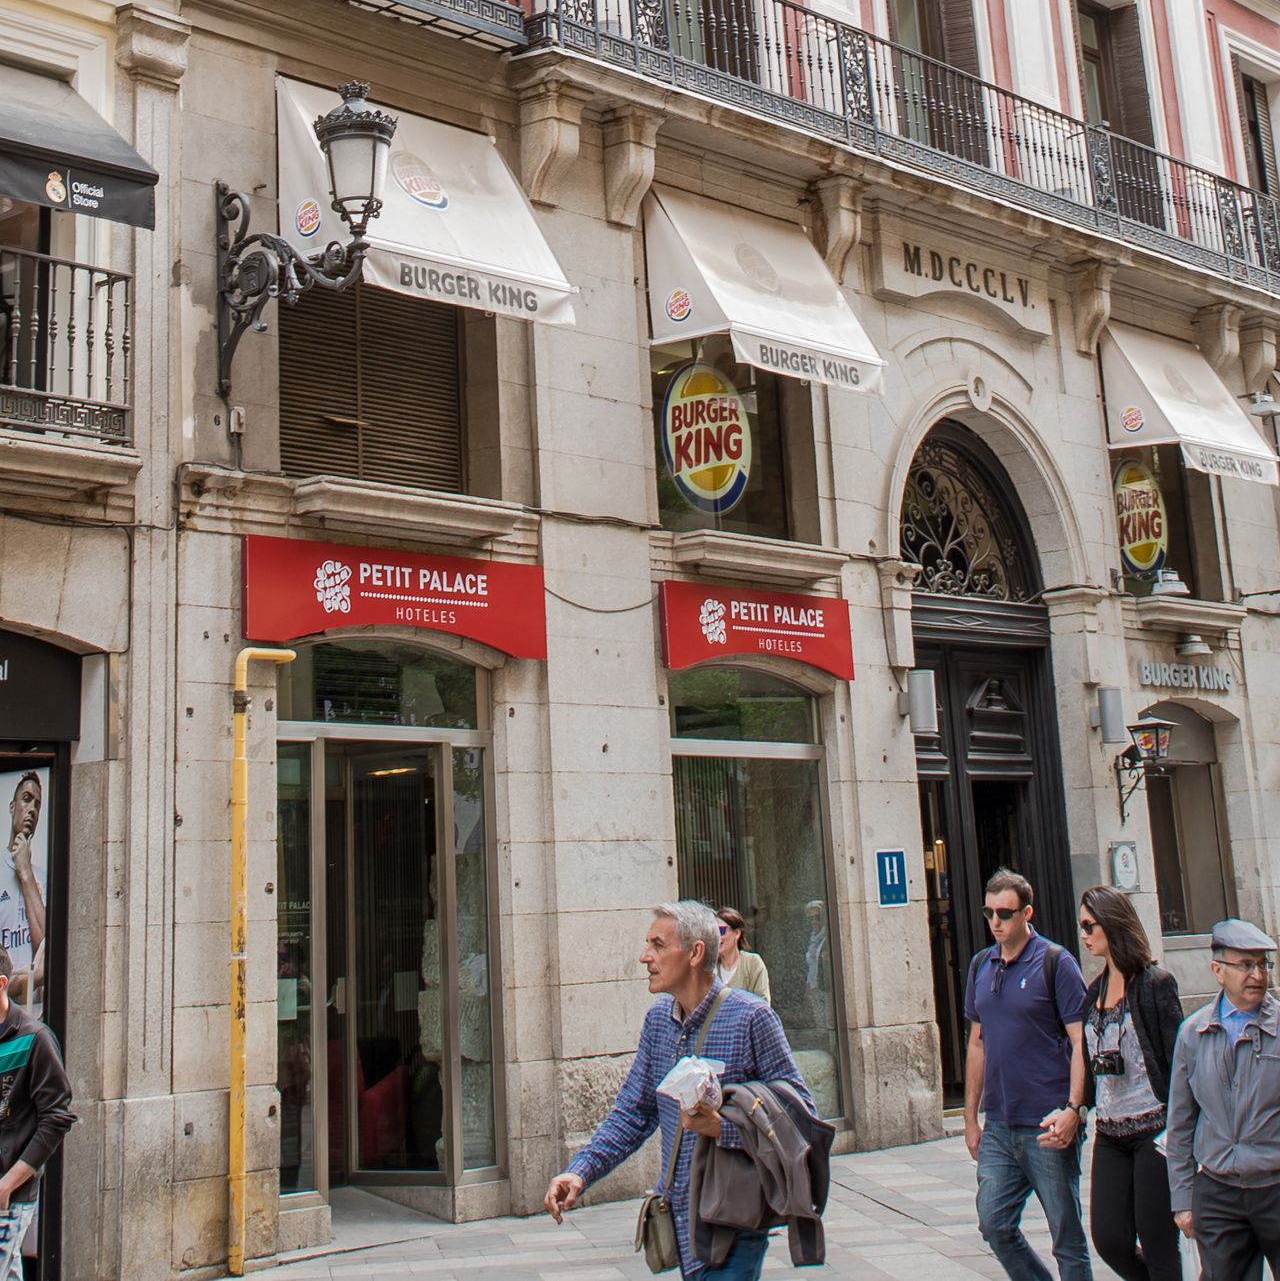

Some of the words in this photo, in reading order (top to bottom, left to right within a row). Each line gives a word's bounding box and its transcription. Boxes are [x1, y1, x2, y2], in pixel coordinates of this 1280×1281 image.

[71, 181, 105, 198] Official
[72, 193, 99, 208] Store
[299, 211, 320, 231] KING
[400, 262, 481, 301] BURGER
[488, 281, 538, 312] KING
[669, 292, 689, 308] BURGER
[669, 298, 690, 318] KING
[759, 343, 820, 376] BURGER
[821, 358, 860, 386] KING
[671, 397, 740, 434] BURGER
[1124, 414, 1143, 427] KING
[674, 423, 743, 474] KING
[1199, 451, 1238, 473] BURGER
[1238, 460, 1263, 478] KING
[1116, 488, 1160, 516] BURGER
[1119, 509, 1162, 548] KING
[359, 562, 413, 589] PETIT
[419, 568, 489, 596] PALACE
[395, 606, 457, 624] HOTELES
[730, 600, 770, 623] PETIT
[773, 604, 825, 628] PALACE
[758, 638, 803, 653] HOTELES
[1140, 661, 1197, 689] BURGER
[1199, 665, 1232, 692] KING
[884, 856, 899, 886] H
[288, 901, 311, 910] PALAC
[1, 924, 33, 950] Emira
